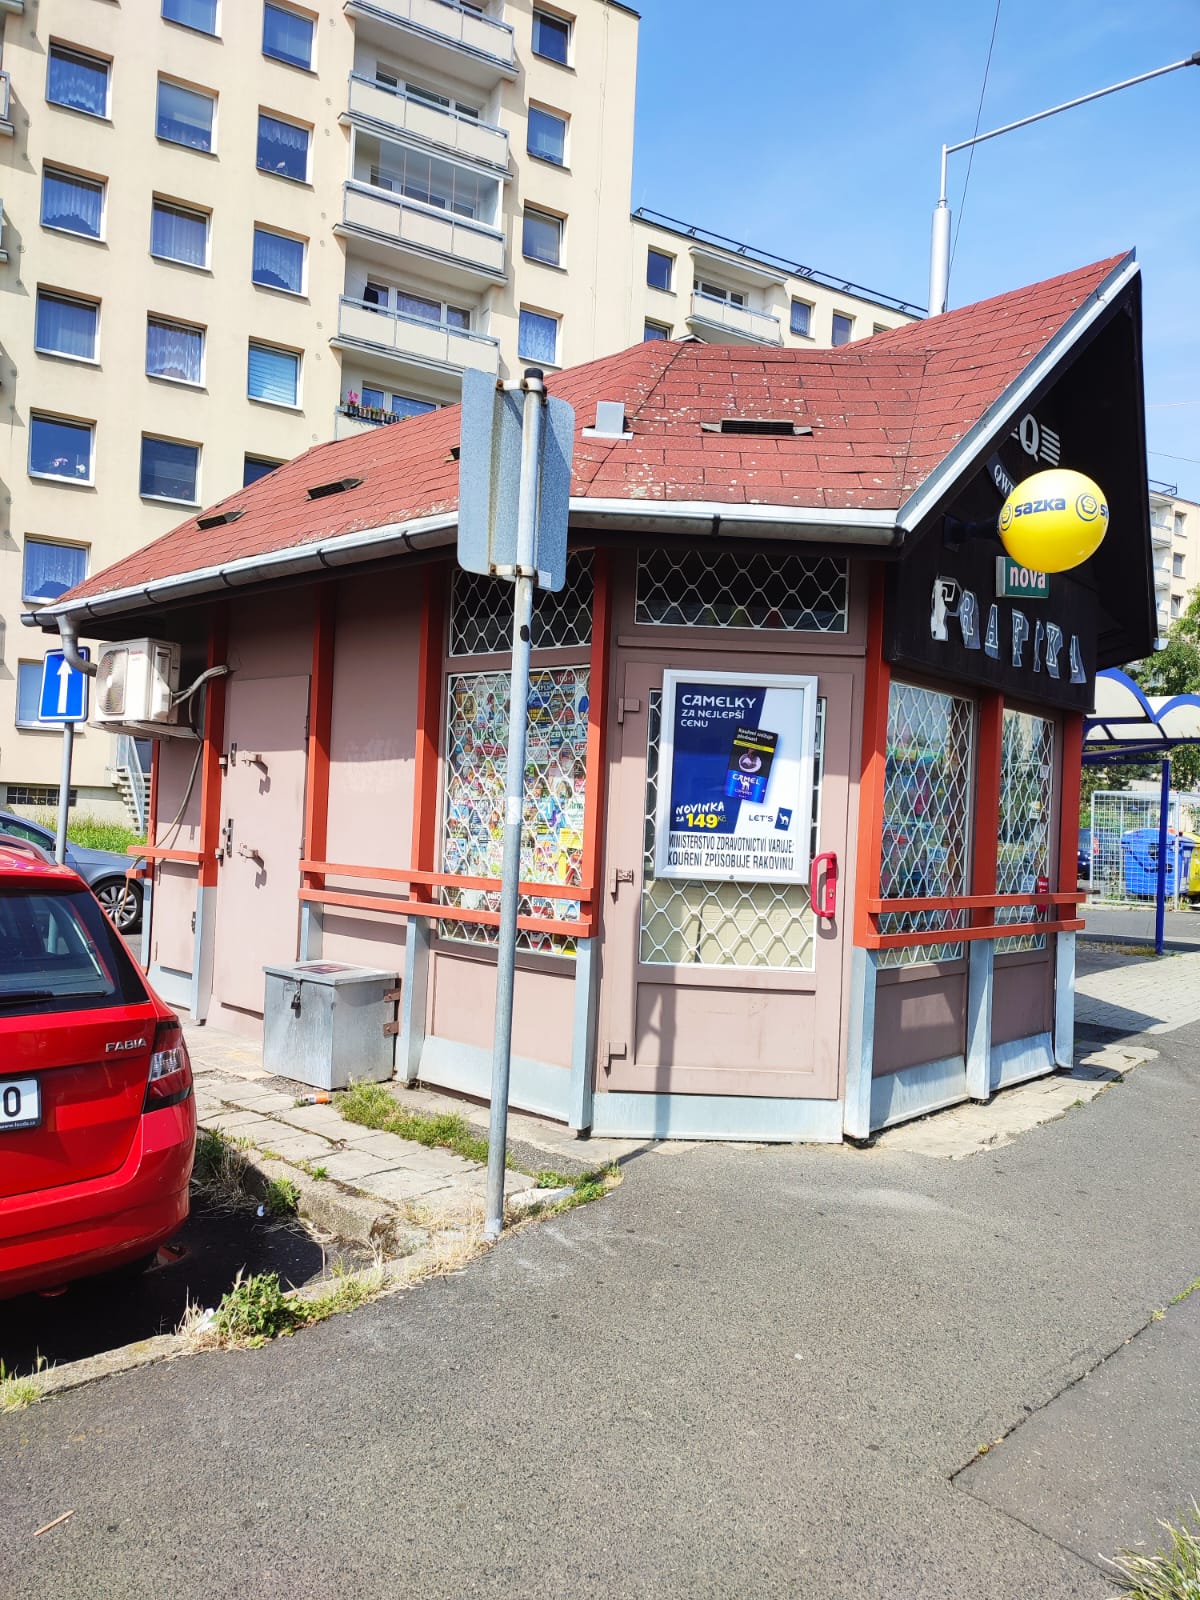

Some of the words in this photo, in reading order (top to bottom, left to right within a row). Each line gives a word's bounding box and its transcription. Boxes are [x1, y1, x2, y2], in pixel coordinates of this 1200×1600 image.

[1009, 566, 1046, 588] nova
[682, 695, 757, 709] CAMELKY
[681, 709, 695, 717] ZA
[697, 709, 745, 719] NEJLEPŠÍ
[680, 719, 709, 728] CENU
[732, 773, 760, 785] CAMEL
[675, 801, 725, 815] NOVINKA
[686, 813, 719, 828] 149
[748, 813, 774, 823] LET'S
[669, 833, 716, 850] MINISTERSTVO
[716, 836, 768, 853] ZDRAVOTNICTVÍ
[667, 849, 702, 866] KOUŘENÍ
[705, 852, 751, 869] ZPŮSOBUJE
[753, 856, 794, 871] RAKOVINU
[105, 1038, 147, 1053] FABIA
